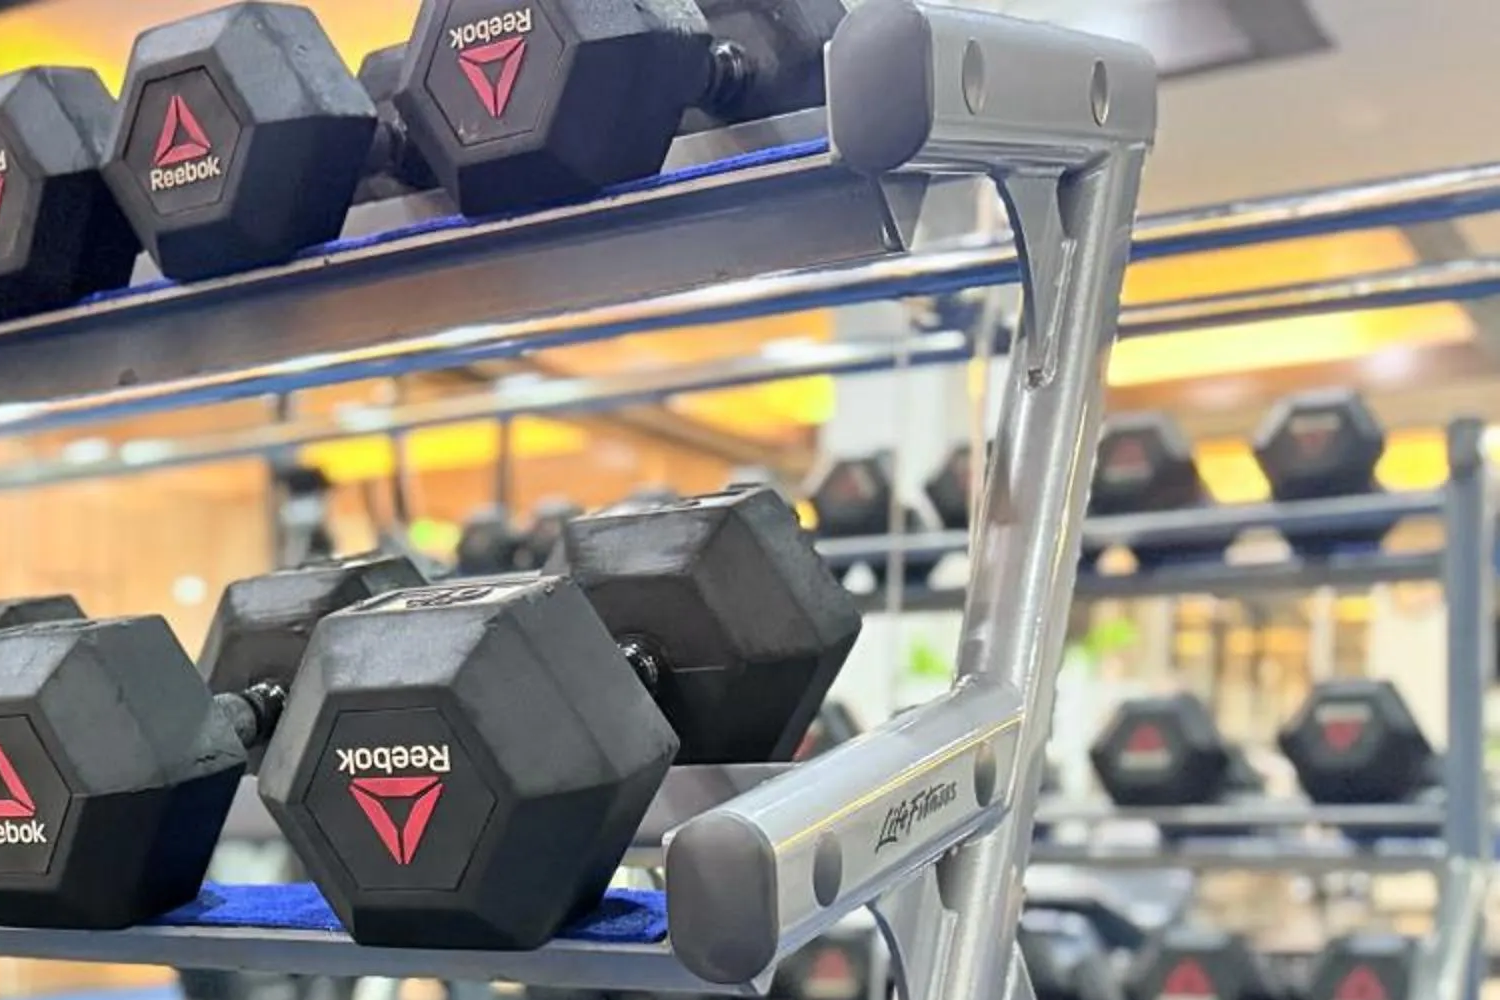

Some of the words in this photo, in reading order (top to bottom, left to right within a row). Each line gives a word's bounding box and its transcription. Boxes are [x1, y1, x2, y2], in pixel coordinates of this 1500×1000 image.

[448, 7, 532, 49] Reebok
[150, 155, 221, 191] Reebok
[336, 744, 450, 775] Reebok
